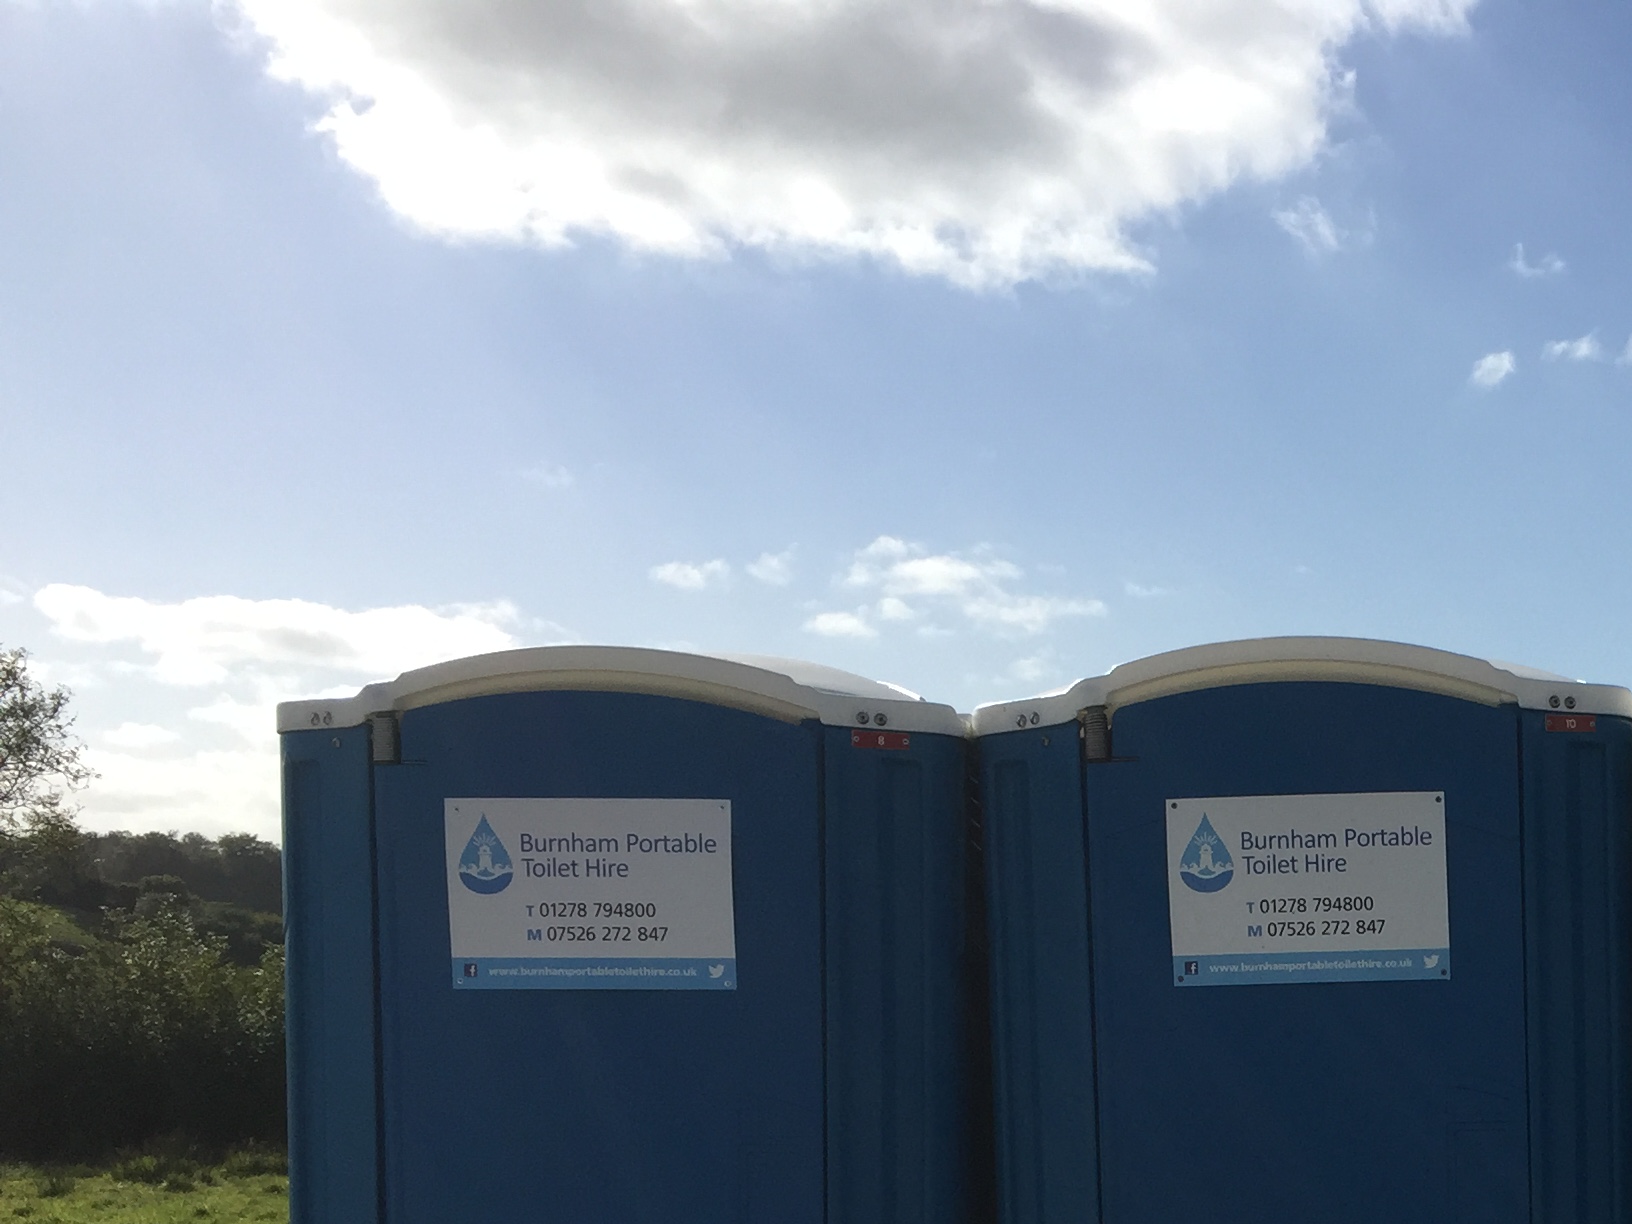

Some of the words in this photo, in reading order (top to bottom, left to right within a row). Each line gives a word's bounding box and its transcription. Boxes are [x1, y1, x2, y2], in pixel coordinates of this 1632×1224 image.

[1566, 719, 1576, 728] 10
[878, 736, 884, 745] 8
[520, 832, 618, 852] Burnham
[627, 833, 716, 853] Portable
[1241, 830, 1336, 850] Burnham
[1345, 826, 1432, 846] Portable
[521, 858, 579, 878] Toilet
[586, 859, 629, 877] Hire
[1242, 856, 1298, 875] Toilet
[1305, 854, 1347, 873] Hire
[526, 906, 534, 917] T
[540, 902, 587, 917] 01278
[594, 903, 656, 918] 794800
[1246, 902, 1254, 914] T
[1260, 898, 1306, 914] 01278
[1313, 897, 1373, 912] 794800
[527, 929, 541, 940] M
[547, 927, 596, 941] 07526
[602, 928, 631, 941] 272
[638, 927, 668, 941] 847
[1248, 926, 1262, 937] M
[1268, 922, 1315, 937] 07526
[1322, 921, 1350, 935] 272
[1356, 920, 1385, 934] 847
[488, 967, 697, 977] www.burnhamportabletoilethire.co.uk
[1210, 959, 1412, 972] www.burnhamportabletoilethire.co.uk
